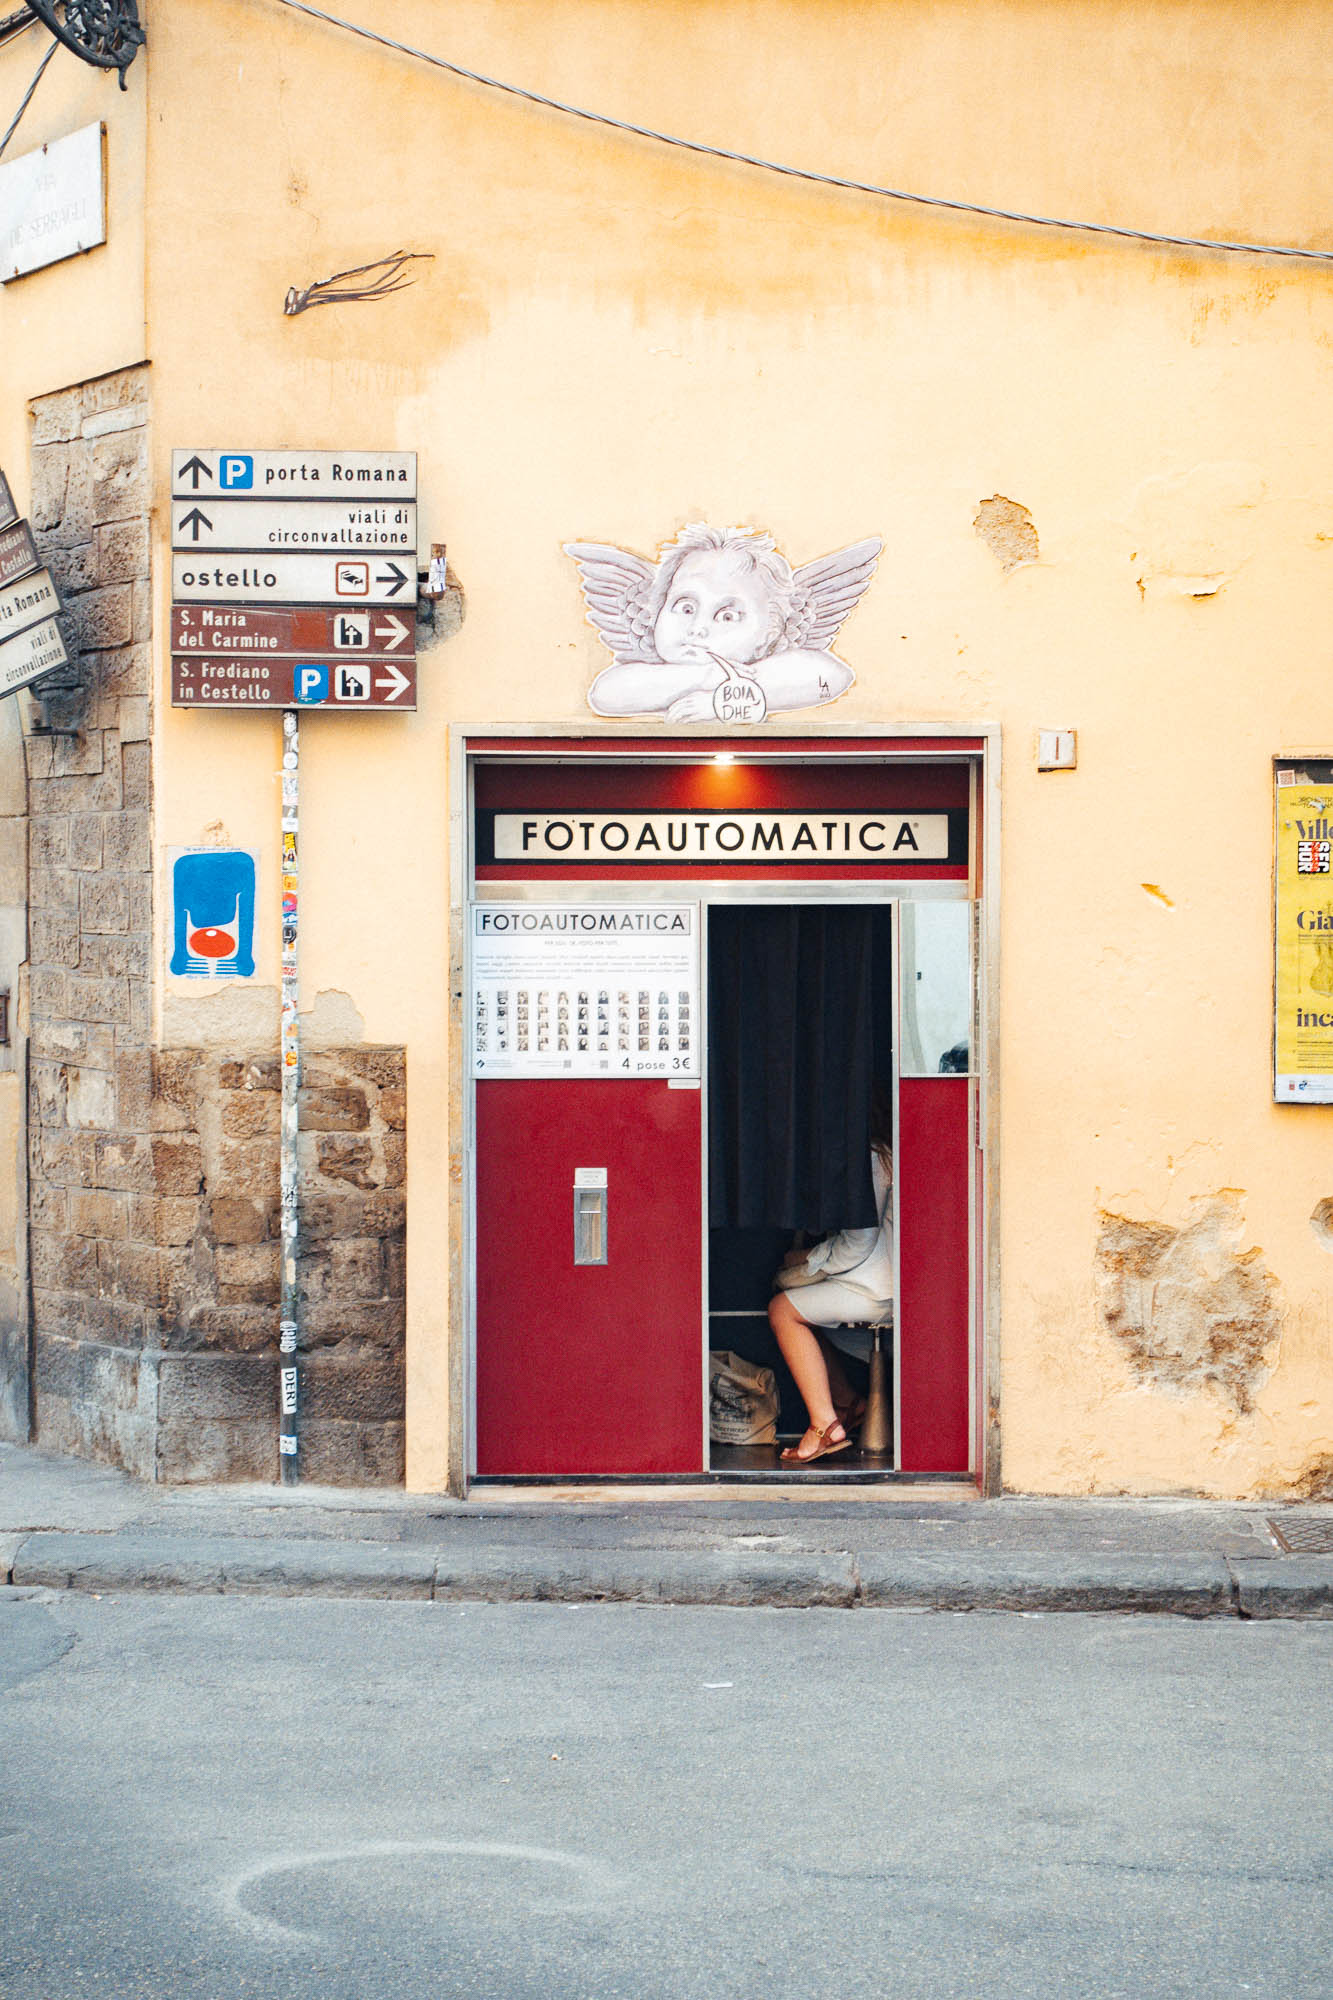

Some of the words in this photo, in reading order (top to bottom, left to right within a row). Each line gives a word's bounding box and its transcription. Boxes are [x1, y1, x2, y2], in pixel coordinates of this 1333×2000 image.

[226, 459, 247, 486] P
[266, 464, 320, 484] porta
[332, 464, 408, 481] Romana
[348, 510, 386, 524] viali
[394, 510, 409, 524] di
[268, 528, 409, 543] circonvallazione
[181, 569, 277, 587] ostello
[14, 586, 52, 612] Romana
[181, 611, 195, 626] S.
[202, 610, 246, 626] Maria
[179, 631, 204, 647] del
[212, 631, 278, 648] Carmine
[6, 647, 63, 682] circonvallazione
[180, 663, 194, 678] S.
[201, 662, 270, 679] Frediano
[179, 684, 194, 699] in
[201, 683, 271, 700] Cestello
[522, 821, 919, 852] FOTOAUTOMATICA
[482, 914, 685, 930] FOTOAUTOMATICA
[1296, 1007, 1333, 1027] inc
[622, 1057, 630, 1070] 4
[637, 1062, 666, 1072] pose
[672, 1057, 691, 1070] 3€
[285, 1371, 296, 1407] DERI
